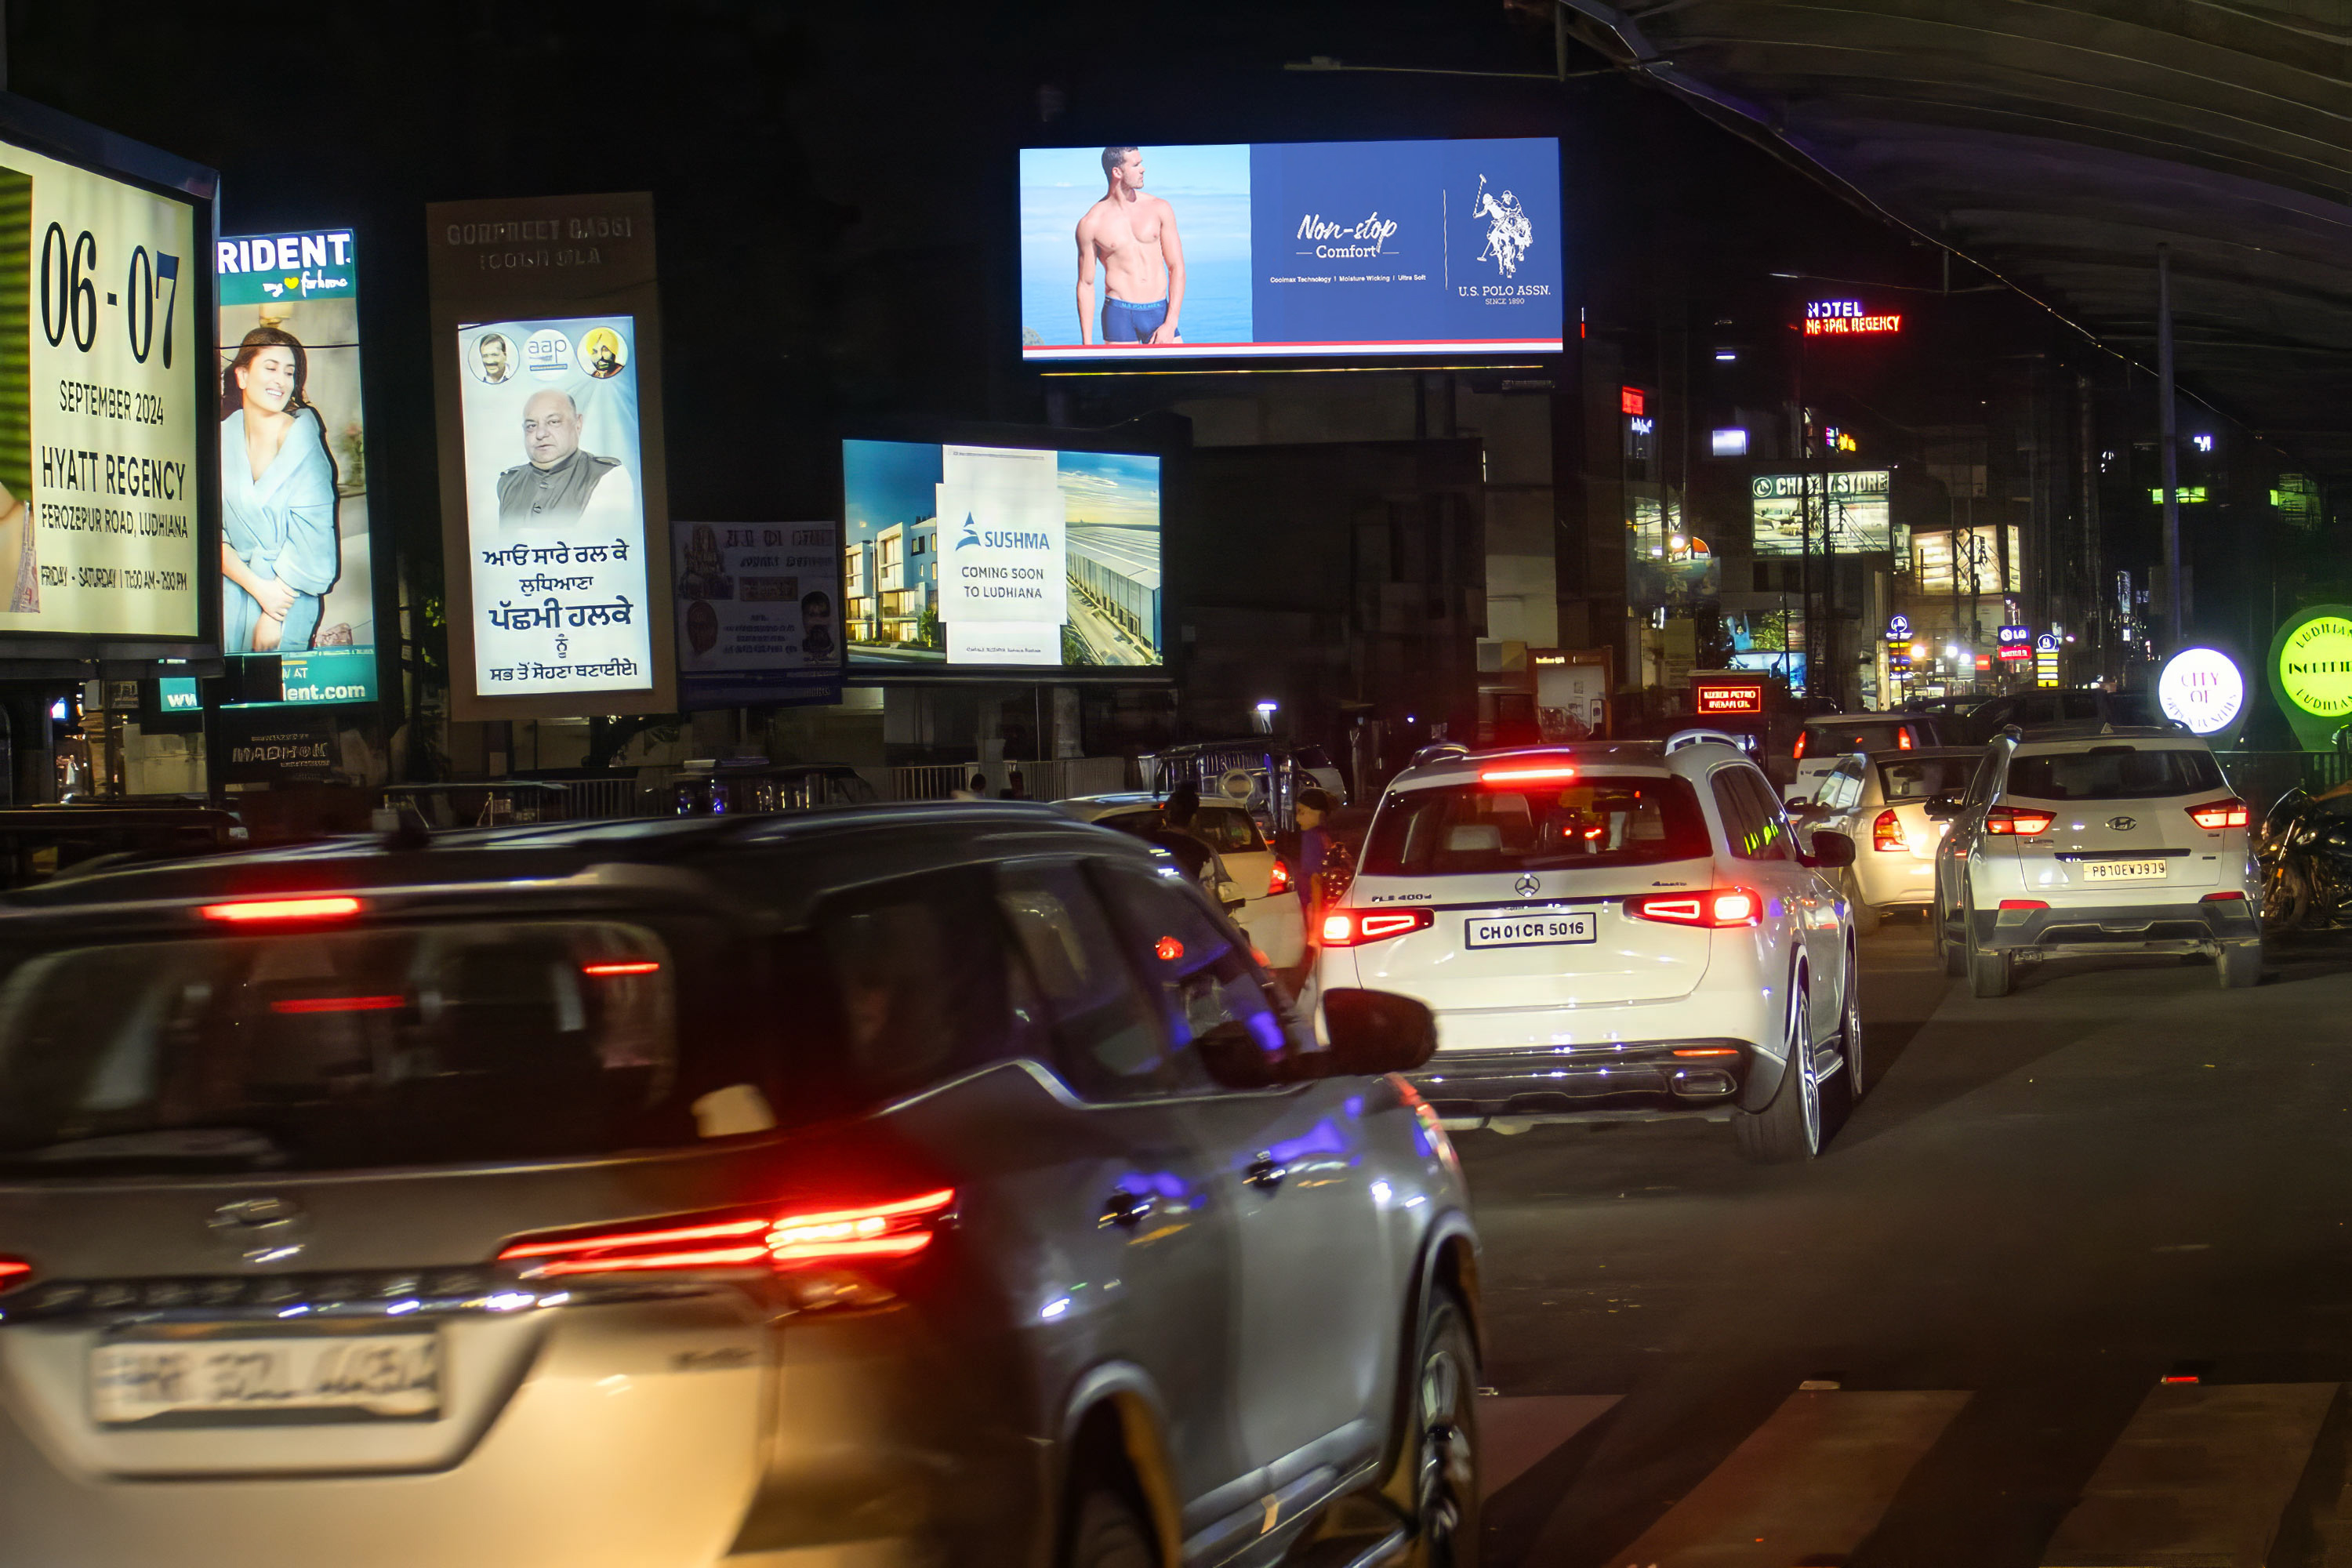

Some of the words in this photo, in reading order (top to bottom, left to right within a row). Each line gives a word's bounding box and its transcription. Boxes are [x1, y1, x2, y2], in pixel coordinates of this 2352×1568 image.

[1297, 212, 1398, 253] Non-stop
[218, 234, 351, 274] RIDENT.
[1316, 245, 1377, 259] Comfort
[1458, 286, 1479, 297] U.S.
[1483, 285, 1514, 296] POLO
[1516, 285, 1551, 296] ASSN.
[1807, 301, 1863, 318] HOTEL
[528, 339, 567, 365] aap
[60, 379, 132, 421] SEPTEMBER
[135, 393, 164, 426] 2024
[42, 445, 99, 492] HYATT
[106, 454, 186, 501] REGENCY
[42, 503, 102, 533] FEROZEPUR
[105, 508, 136, 538] ROAD,
[140, 511, 188, 539] LUDHIANA
[985, 531, 1051, 550] SUSHMA
[532, 541, 572, 564] ਸਾਰੇ
[573, 546, 608, 563] ਰਲ
[610, 538, 630, 561] ਕੇ
[961, 566, 1008, 579] COMING
[1011, 568, 1044, 580] SOON
[518, 573, 594, 597] ਲੁਧਿਆਣਾ
[963, 586, 980, 598] TO
[983, 586, 1043, 599] LUDHIANA
[488, 597, 563, 630] ਪੱਛਮੀ
[565, 594, 634, 627] ਹਲਕੇ
[293, 668, 308, 679] AT
[516, 662, 531, 681] ਤੋਂ
[531, 662, 573, 680] ਸੋਹਣਾ
[2181, 672, 2219, 688] CITY
[1548, 921, 1584, 936] 5016
